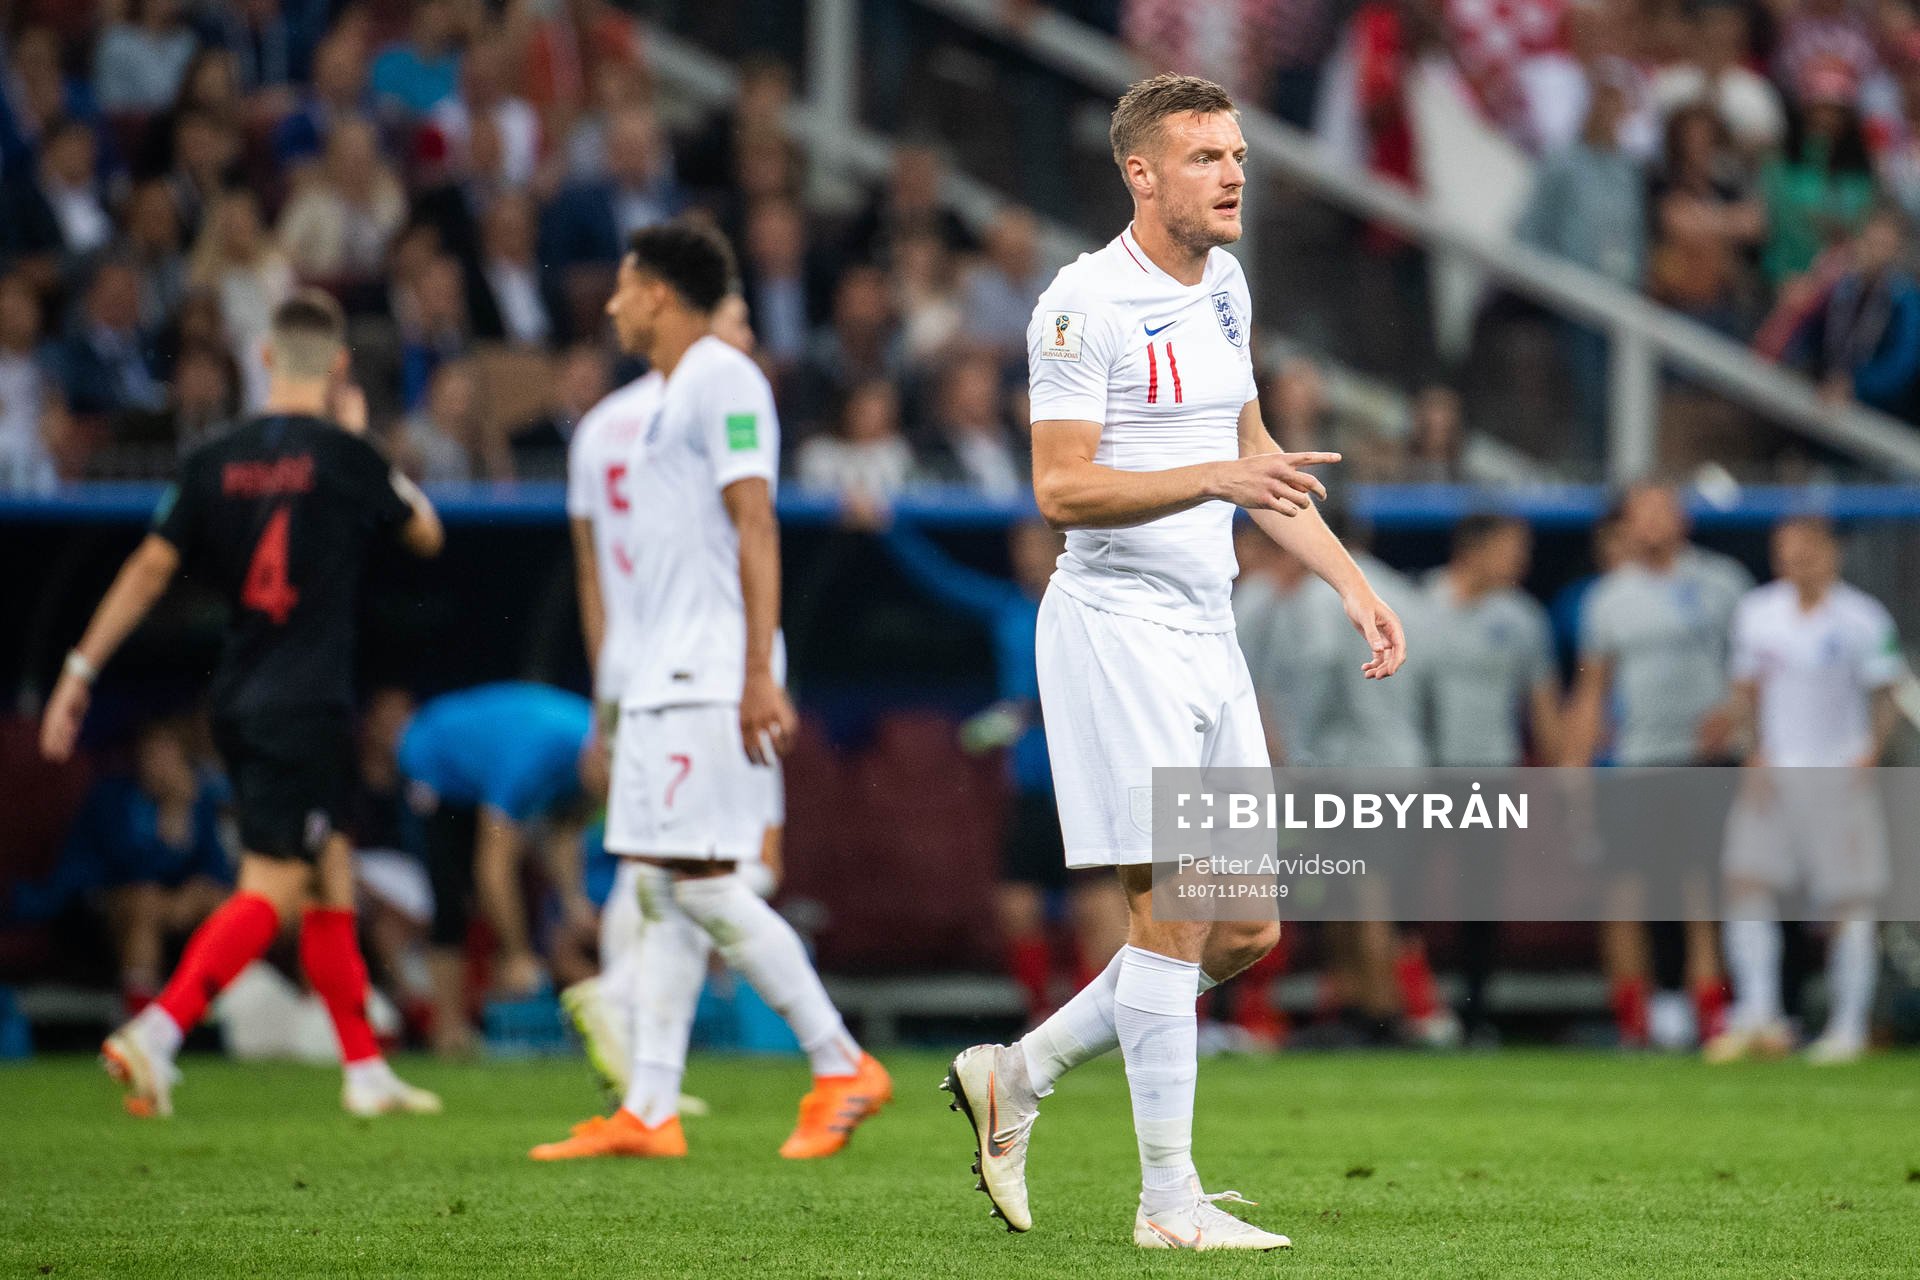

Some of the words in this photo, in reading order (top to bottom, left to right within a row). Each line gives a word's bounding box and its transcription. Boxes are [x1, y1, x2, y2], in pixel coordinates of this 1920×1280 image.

[1146, 341, 1182, 404] 11
[242, 505, 299, 624] 4
[664, 754, 692, 810] 7
